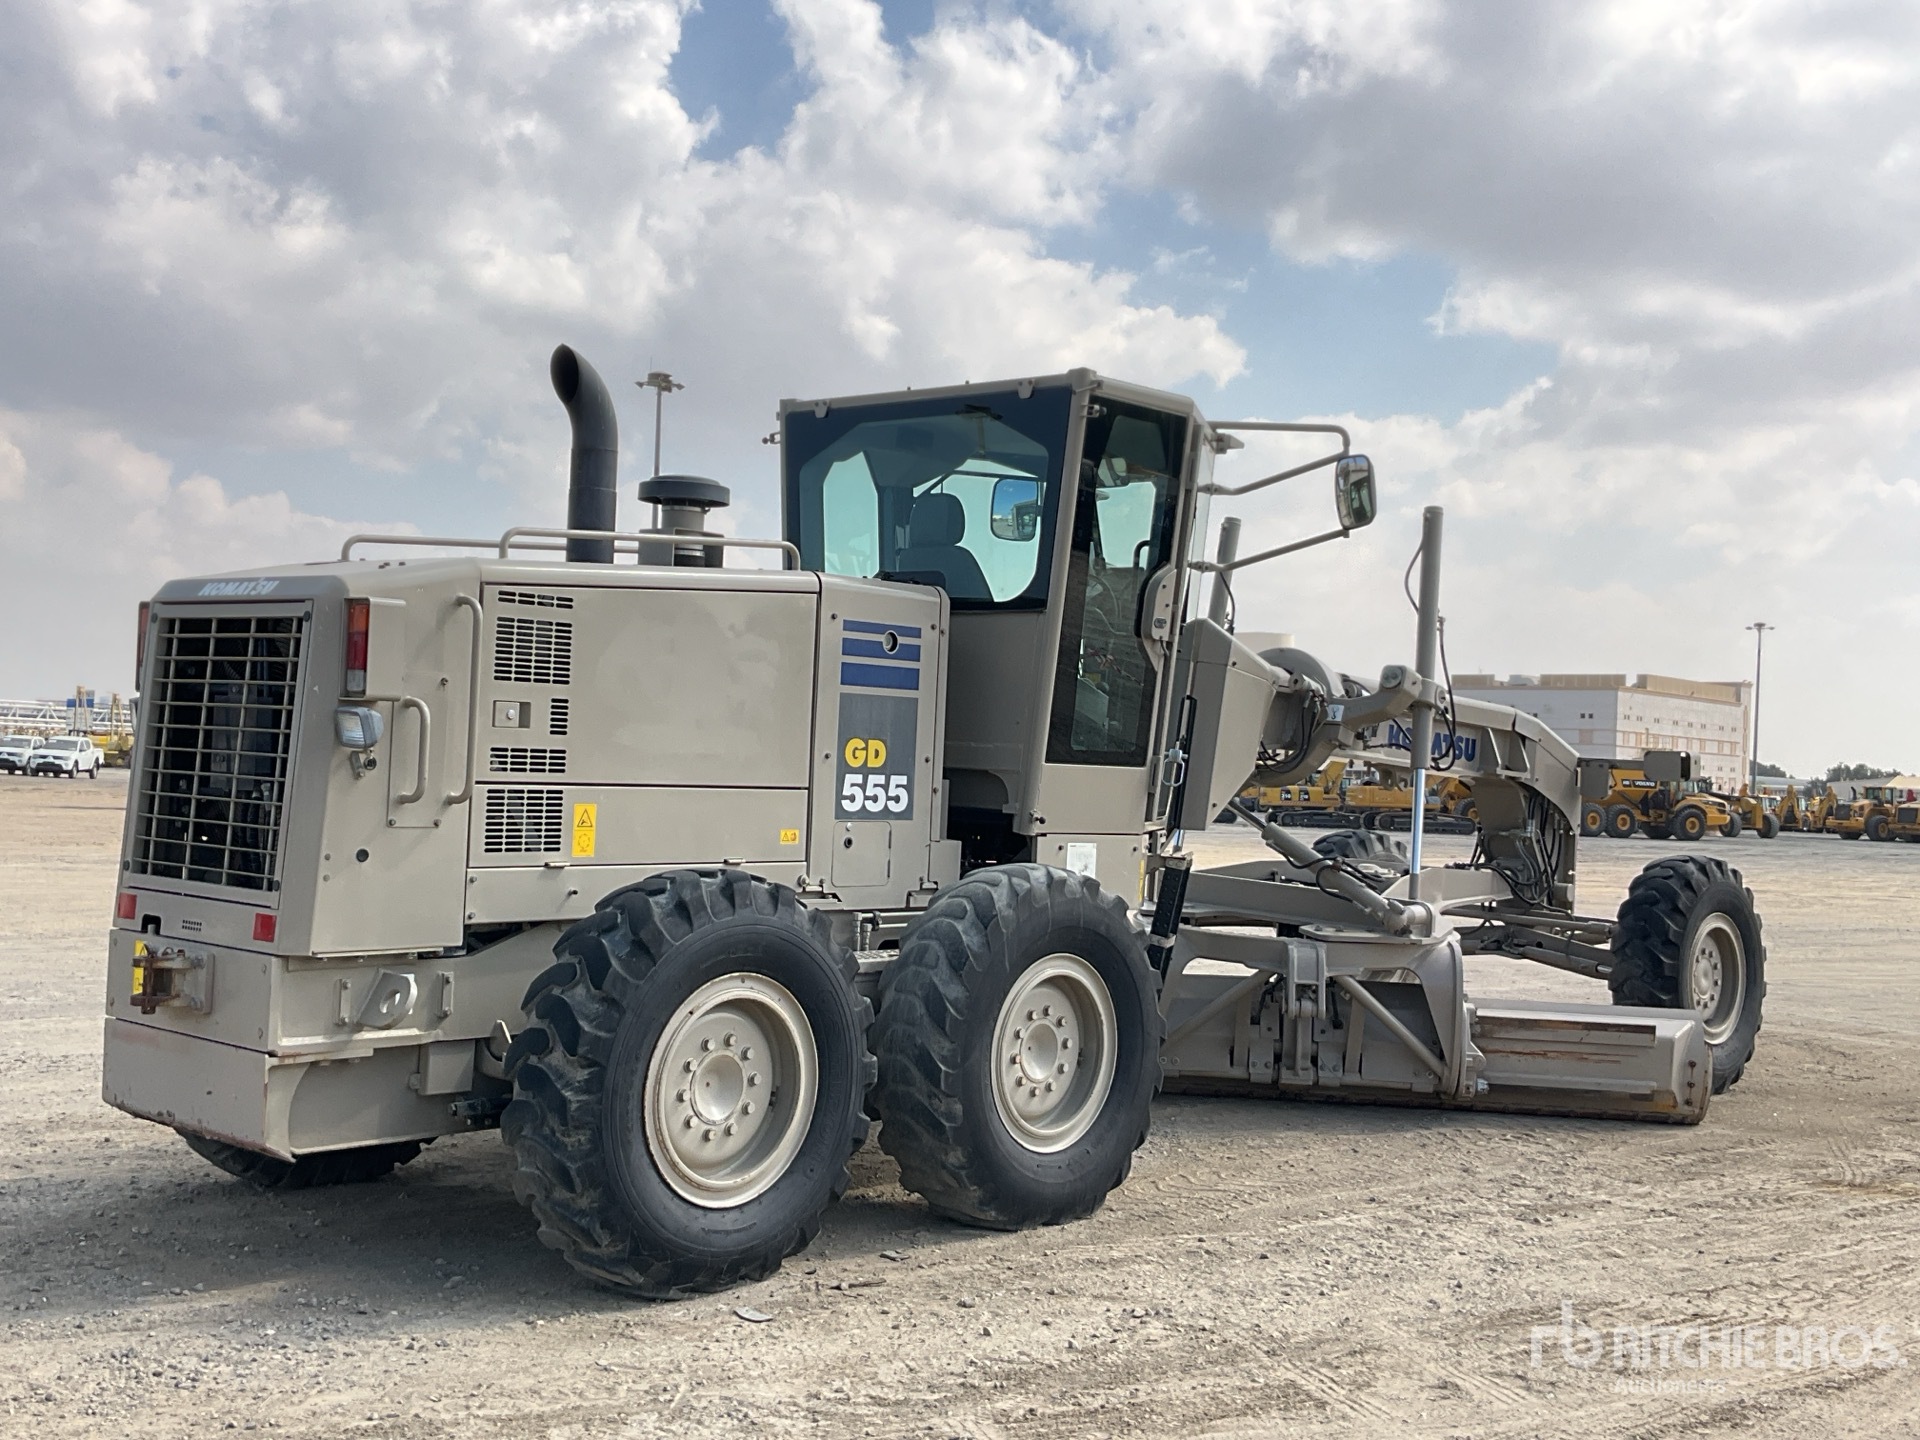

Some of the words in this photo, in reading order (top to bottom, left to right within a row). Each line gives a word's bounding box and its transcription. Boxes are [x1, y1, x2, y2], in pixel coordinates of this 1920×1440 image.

[198, 580, 280, 596] KOMATSU
[844, 737, 887, 768] GD
[840, 773, 909, 813] 555
